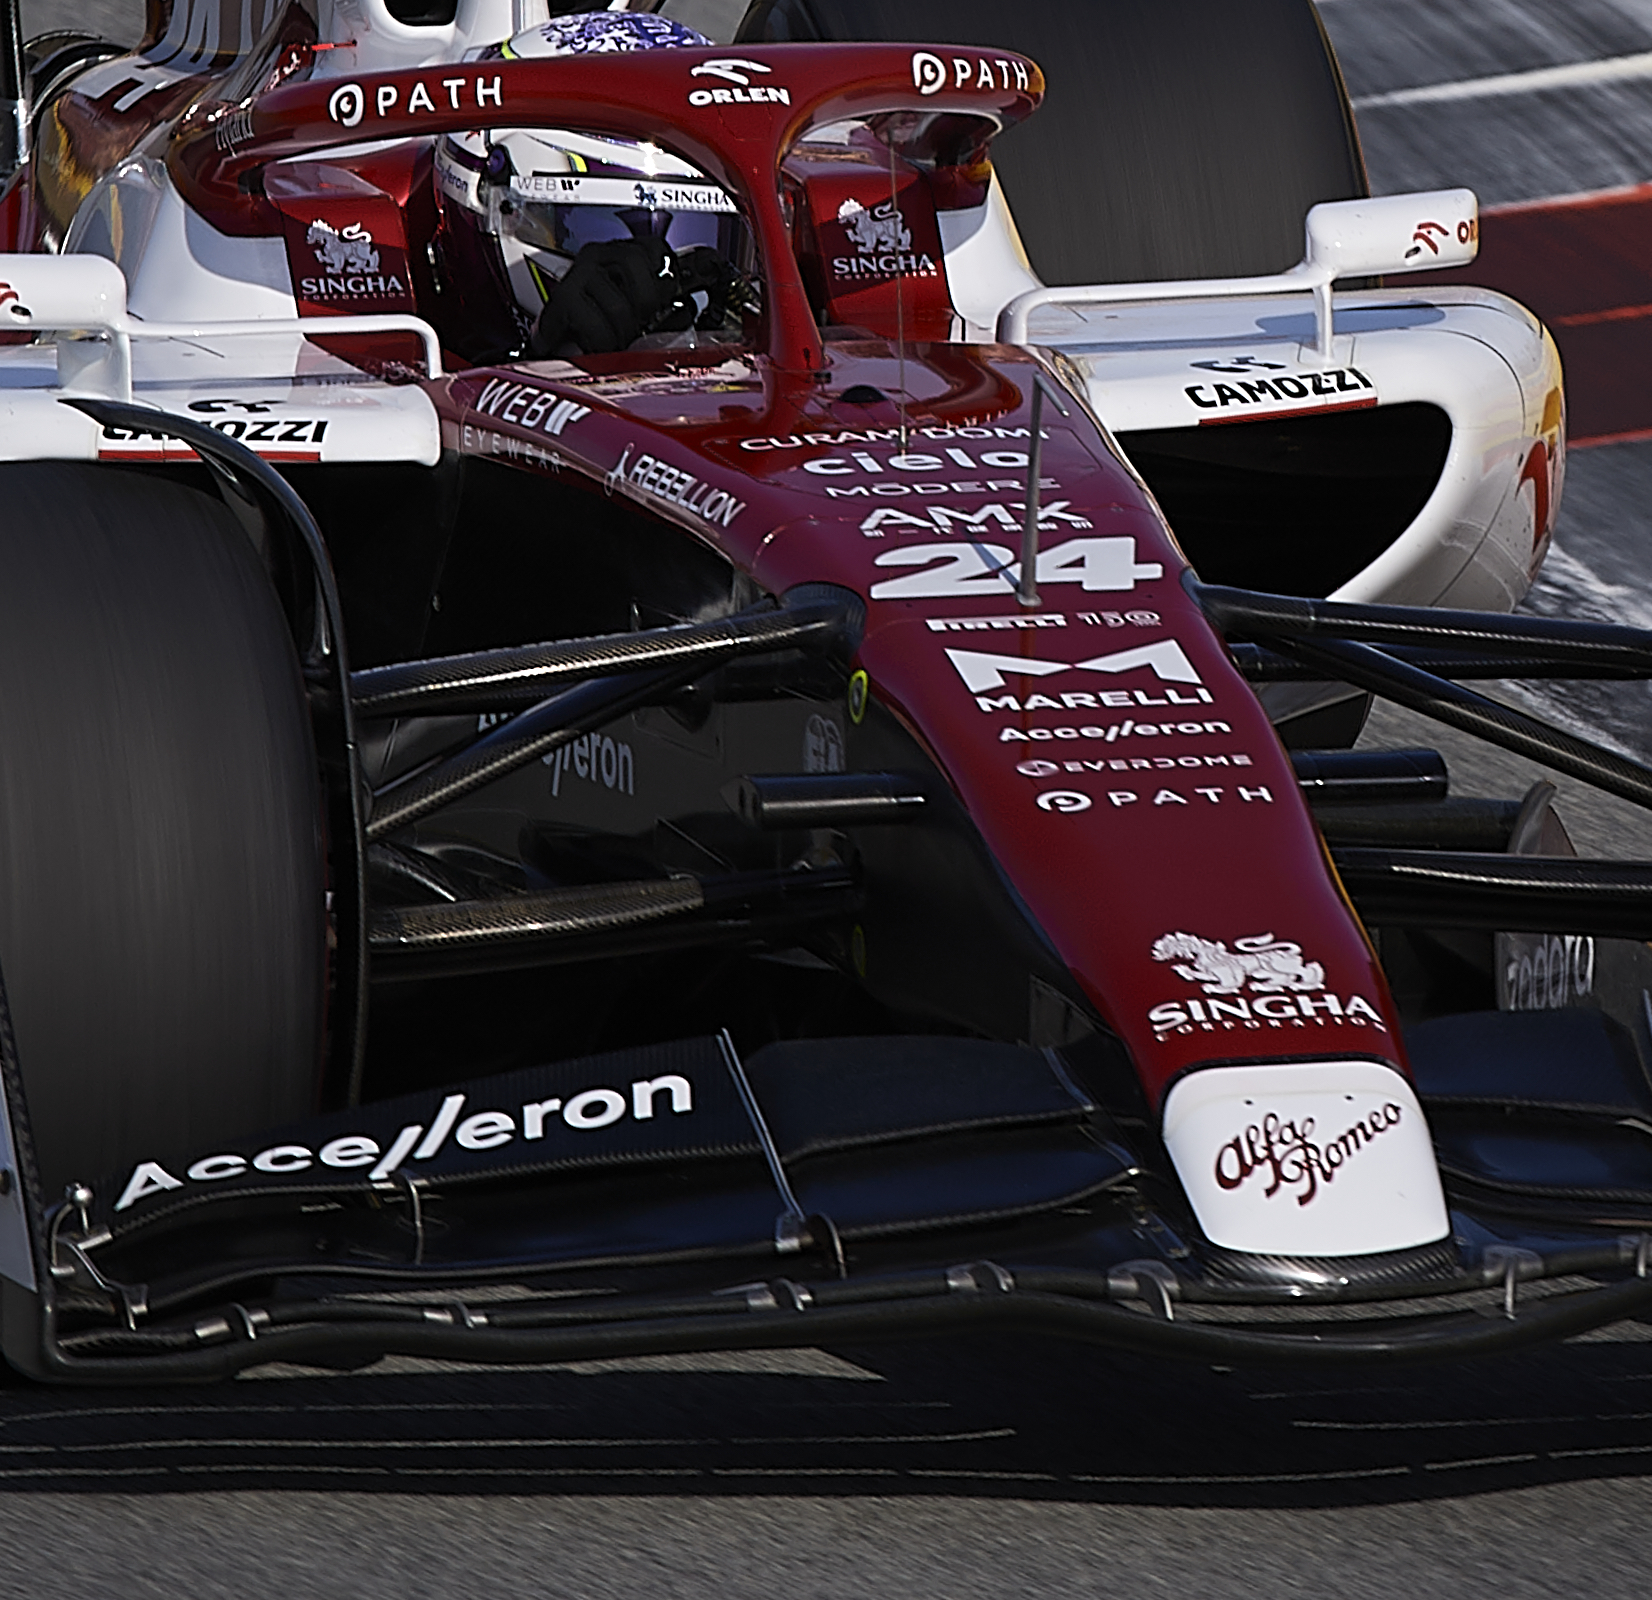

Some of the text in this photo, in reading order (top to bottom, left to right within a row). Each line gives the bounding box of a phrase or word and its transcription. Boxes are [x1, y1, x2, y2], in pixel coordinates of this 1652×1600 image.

[952, 57, 1030, 92] PATH
[376, 75, 503, 117] PATH
[687, 86, 791, 107] ORLEN
[516, 176, 557, 191] WEB
[832, 253, 937, 275] SINGHA
[300, 274, 404, 295] SINGHA
[475, 377, 557, 429] WEB
[1184, 367, 1374, 409] CAMOZZI
[463, 424, 563, 475] EYEWEAR
[802, 447, 1032, 476] cielo
[859, 500, 1091, 532] AMX
[869, 535, 1164, 600] 24
[974, 686, 1216, 714] MARELLI
[998, 718, 1233, 743] Accelleron
[1062, 753, 1255, 775] EVERDOME
[1107, 785, 1275, 808] PATH
[1147, 993, 1385, 1033] SINGHA
[112, 1072, 696, 1213] Accelleron
[1280, 1101, 1402, 1207] Romeo
